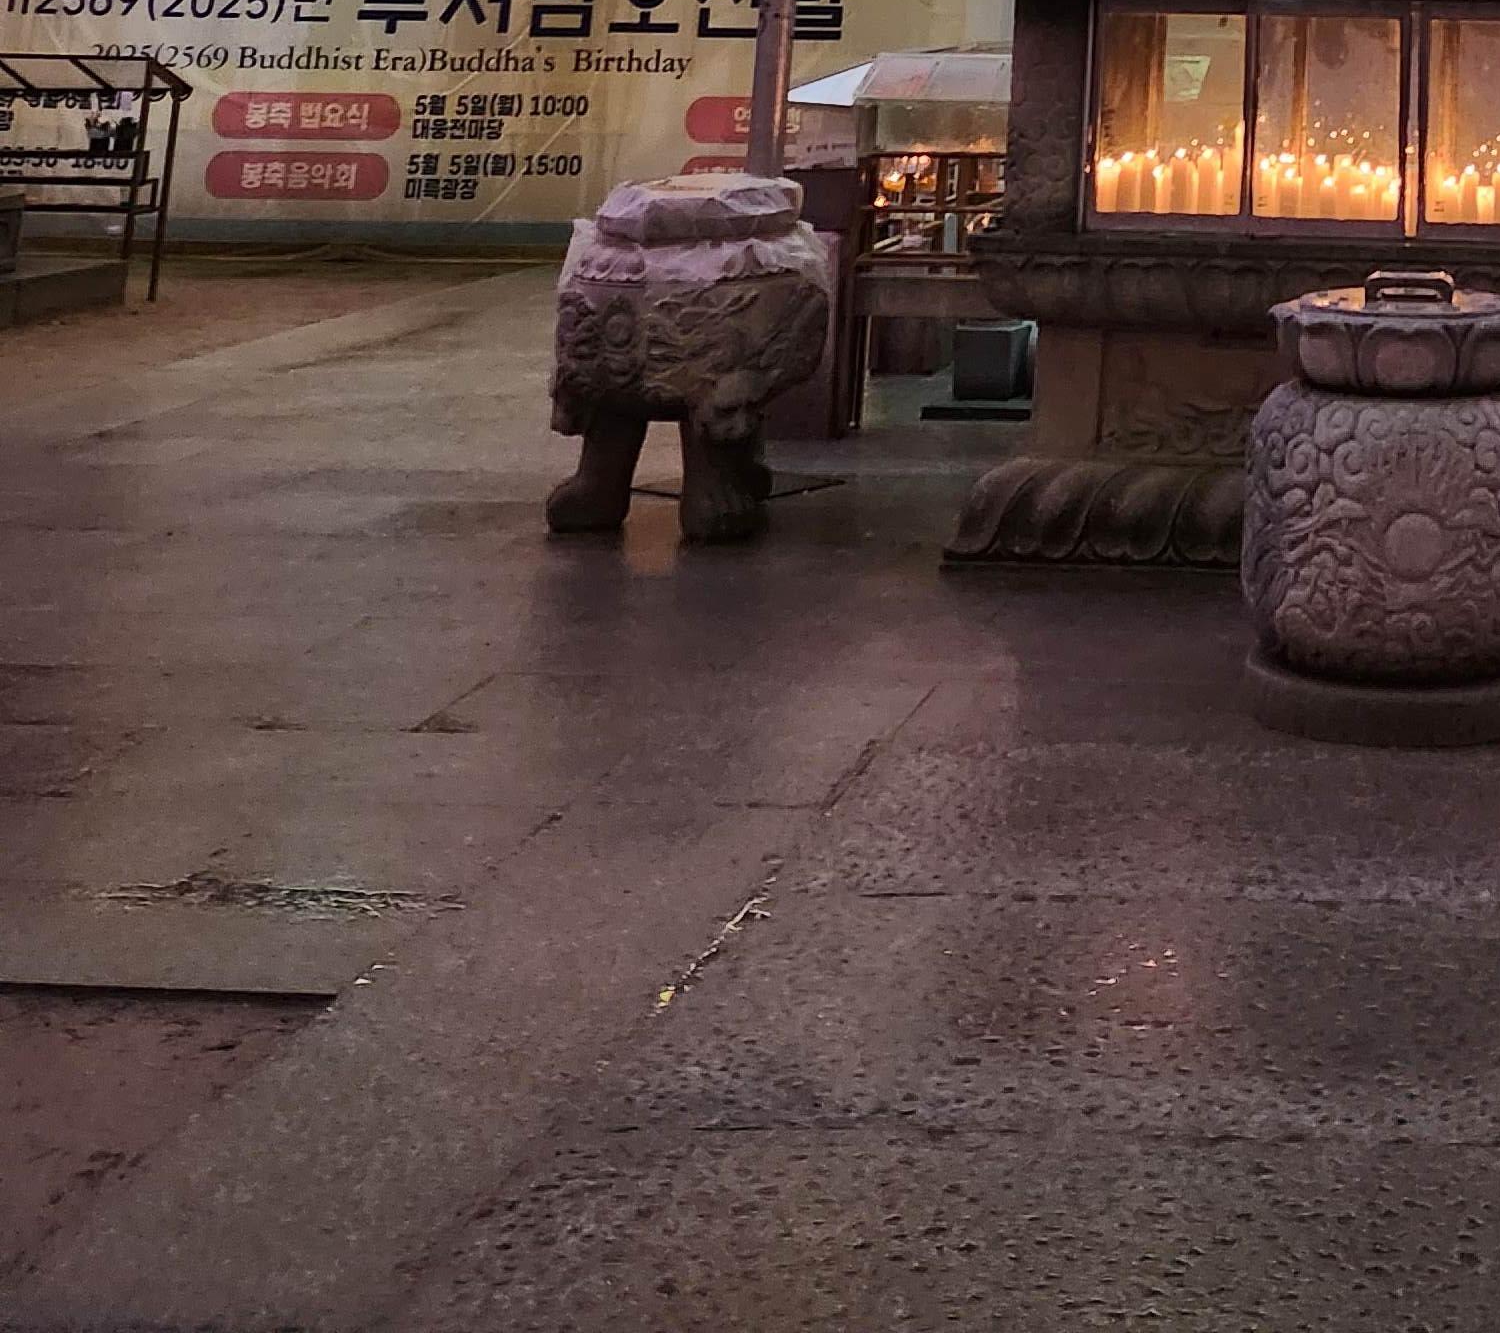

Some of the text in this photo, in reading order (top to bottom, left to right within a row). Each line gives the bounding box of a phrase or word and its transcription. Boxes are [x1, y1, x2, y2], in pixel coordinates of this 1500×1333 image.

[237, 44, 364, 72] Buddhist
[573, 49, 692, 80] Birthday
[414, 93, 589, 118] 5월 5일(월) 10:00
[407, 153, 583, 178] 5월 5일(월) 15:00
